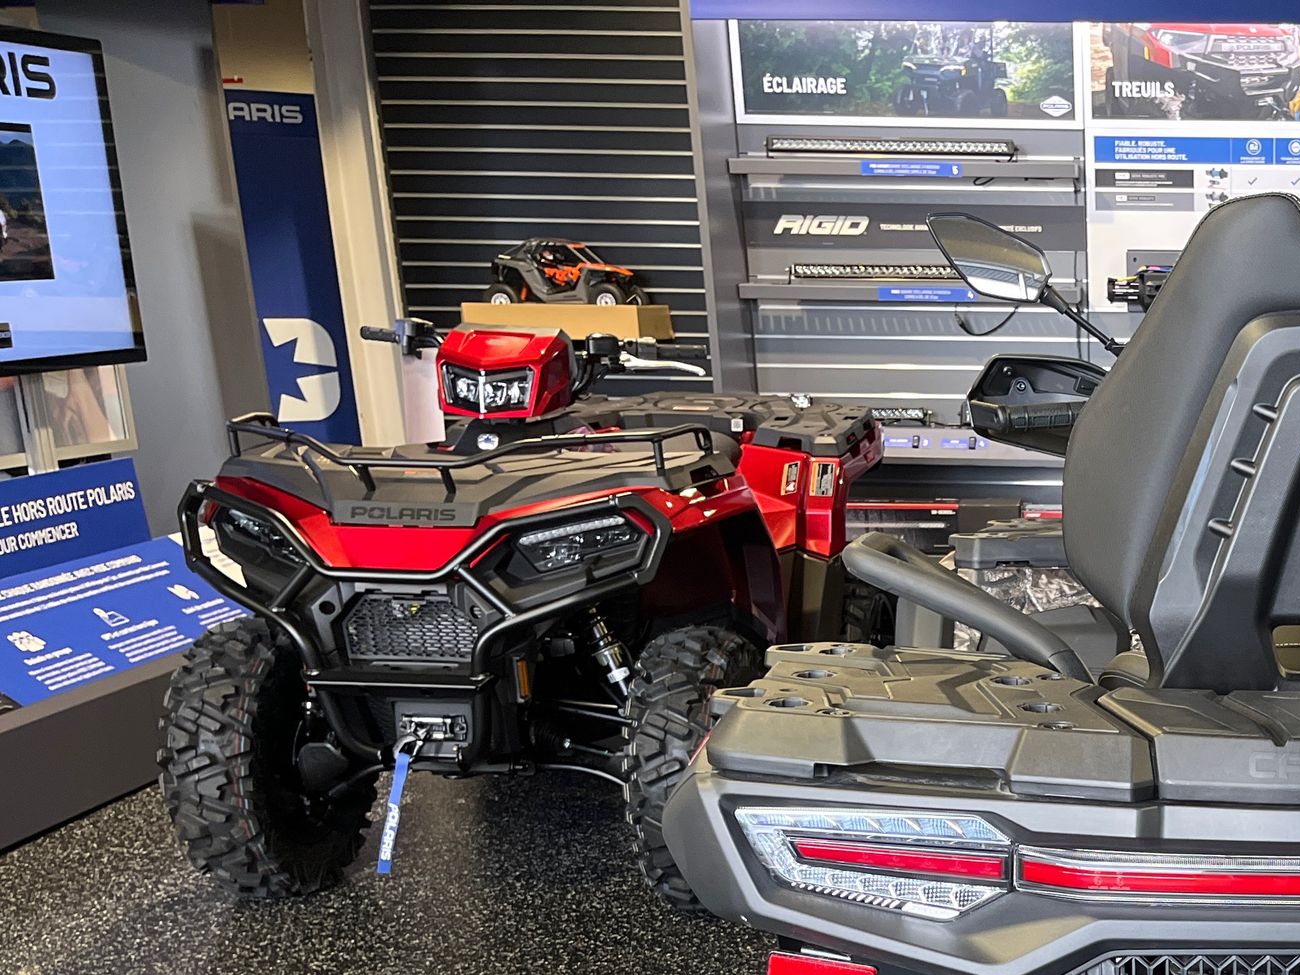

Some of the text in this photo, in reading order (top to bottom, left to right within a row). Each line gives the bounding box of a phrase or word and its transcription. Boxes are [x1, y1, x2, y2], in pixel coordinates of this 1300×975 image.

[763, 73, 848, 95] ÉCLAIRAGE
[1112, 81, 1176, 98] TREUILS
[228, 102, 304, 124] ARIS
[773, 214, 869, 236] RIGID
[0, 481, 136, 528] E HORS ROUTE POLARIS
[350, 506, 456, 521] POLARIS
[18, 522, 80, 550] COMMENCER
[379, 802, 401, 861] POLARIS
